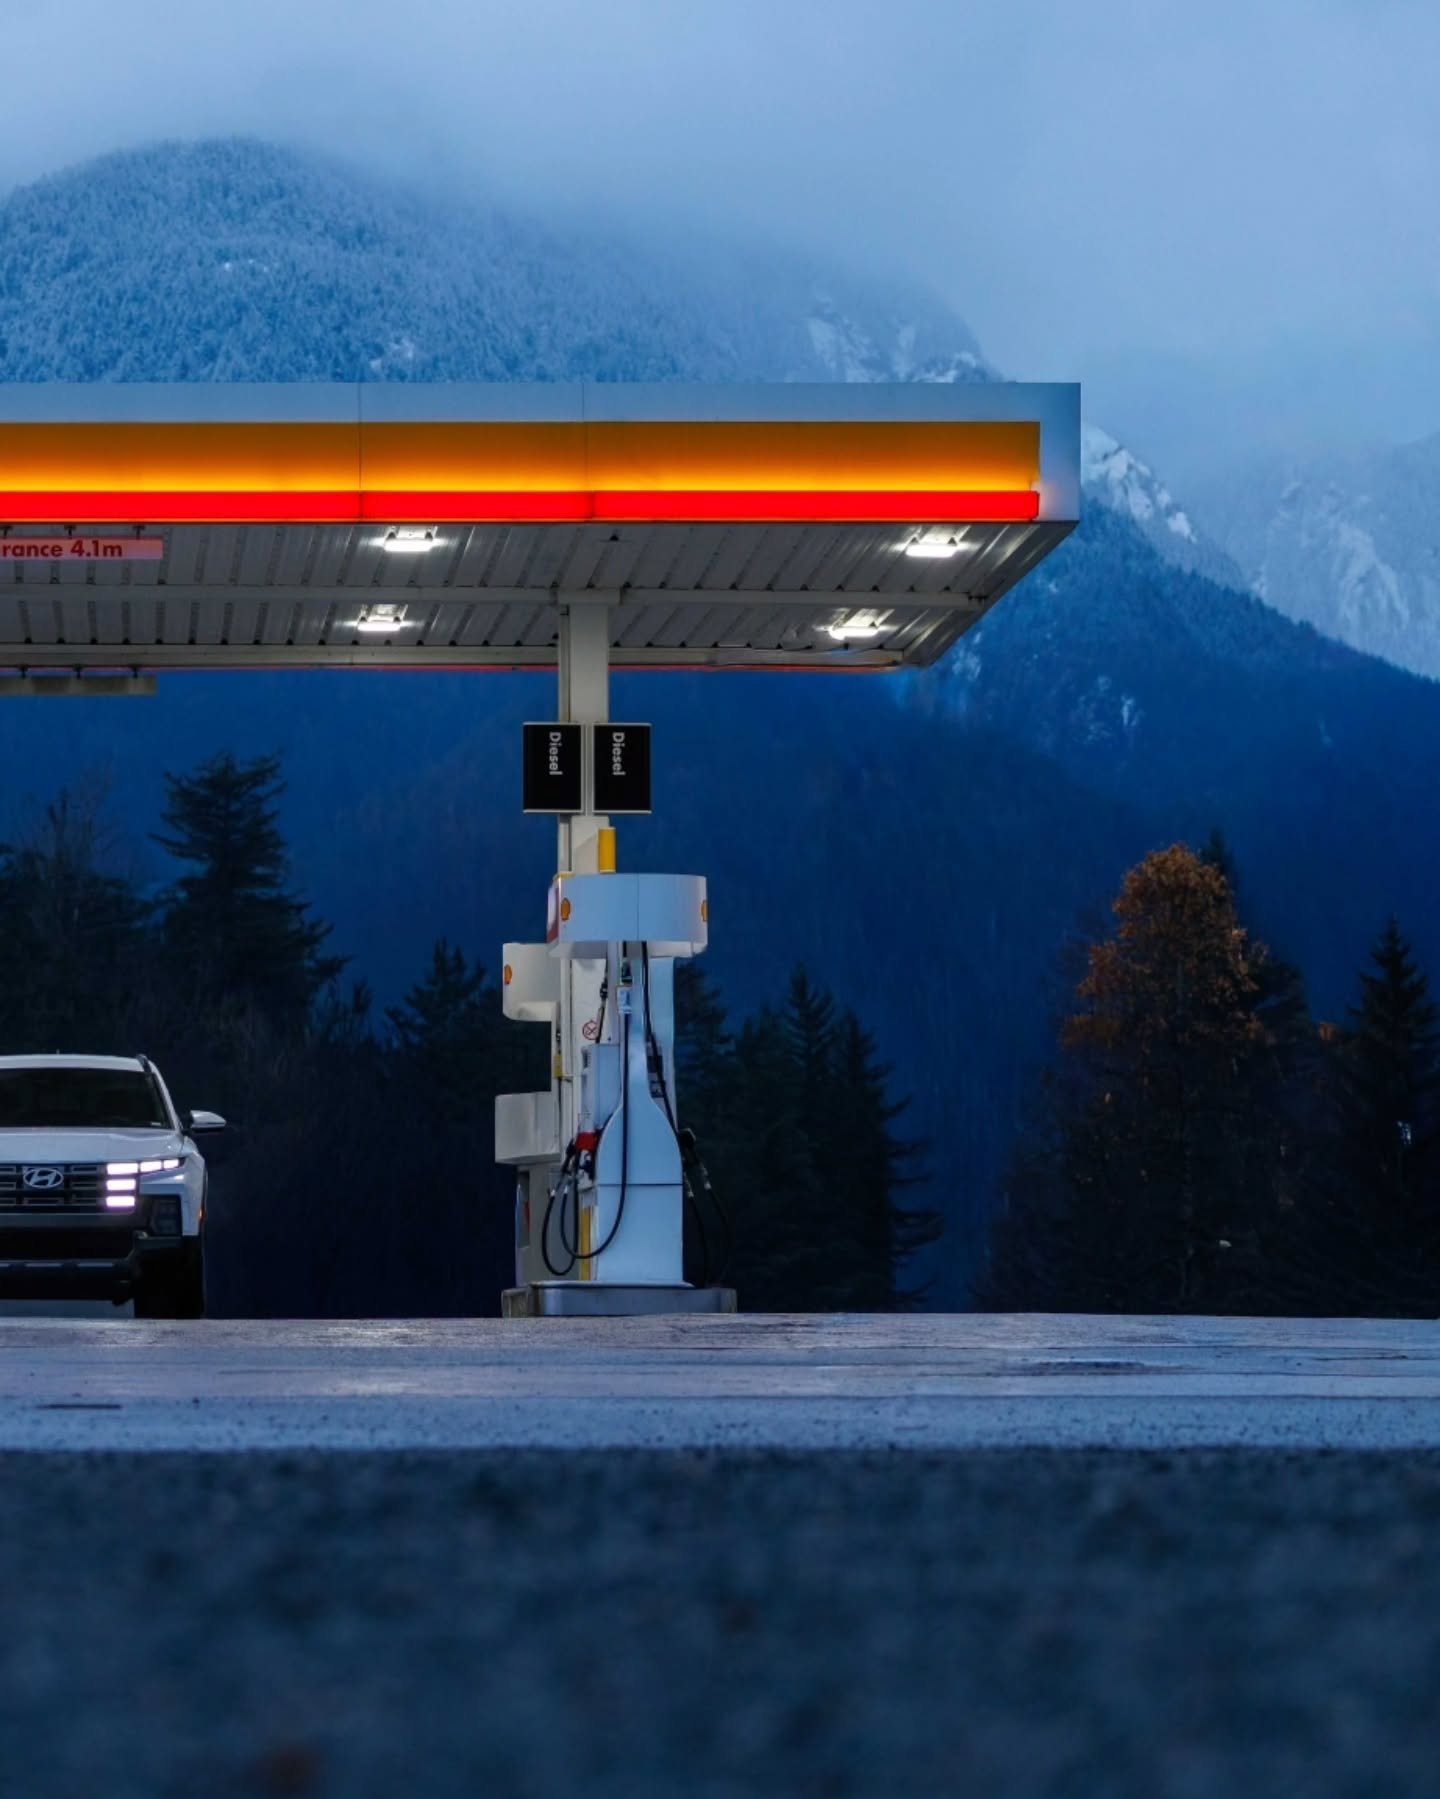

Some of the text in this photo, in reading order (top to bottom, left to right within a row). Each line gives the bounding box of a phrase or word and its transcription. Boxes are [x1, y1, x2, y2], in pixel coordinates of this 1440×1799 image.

[2, 540, 123, 558] rance 4.1m
[549, 731, 563, 775] Diesel
[612, 732, 626, 776] Diesel
